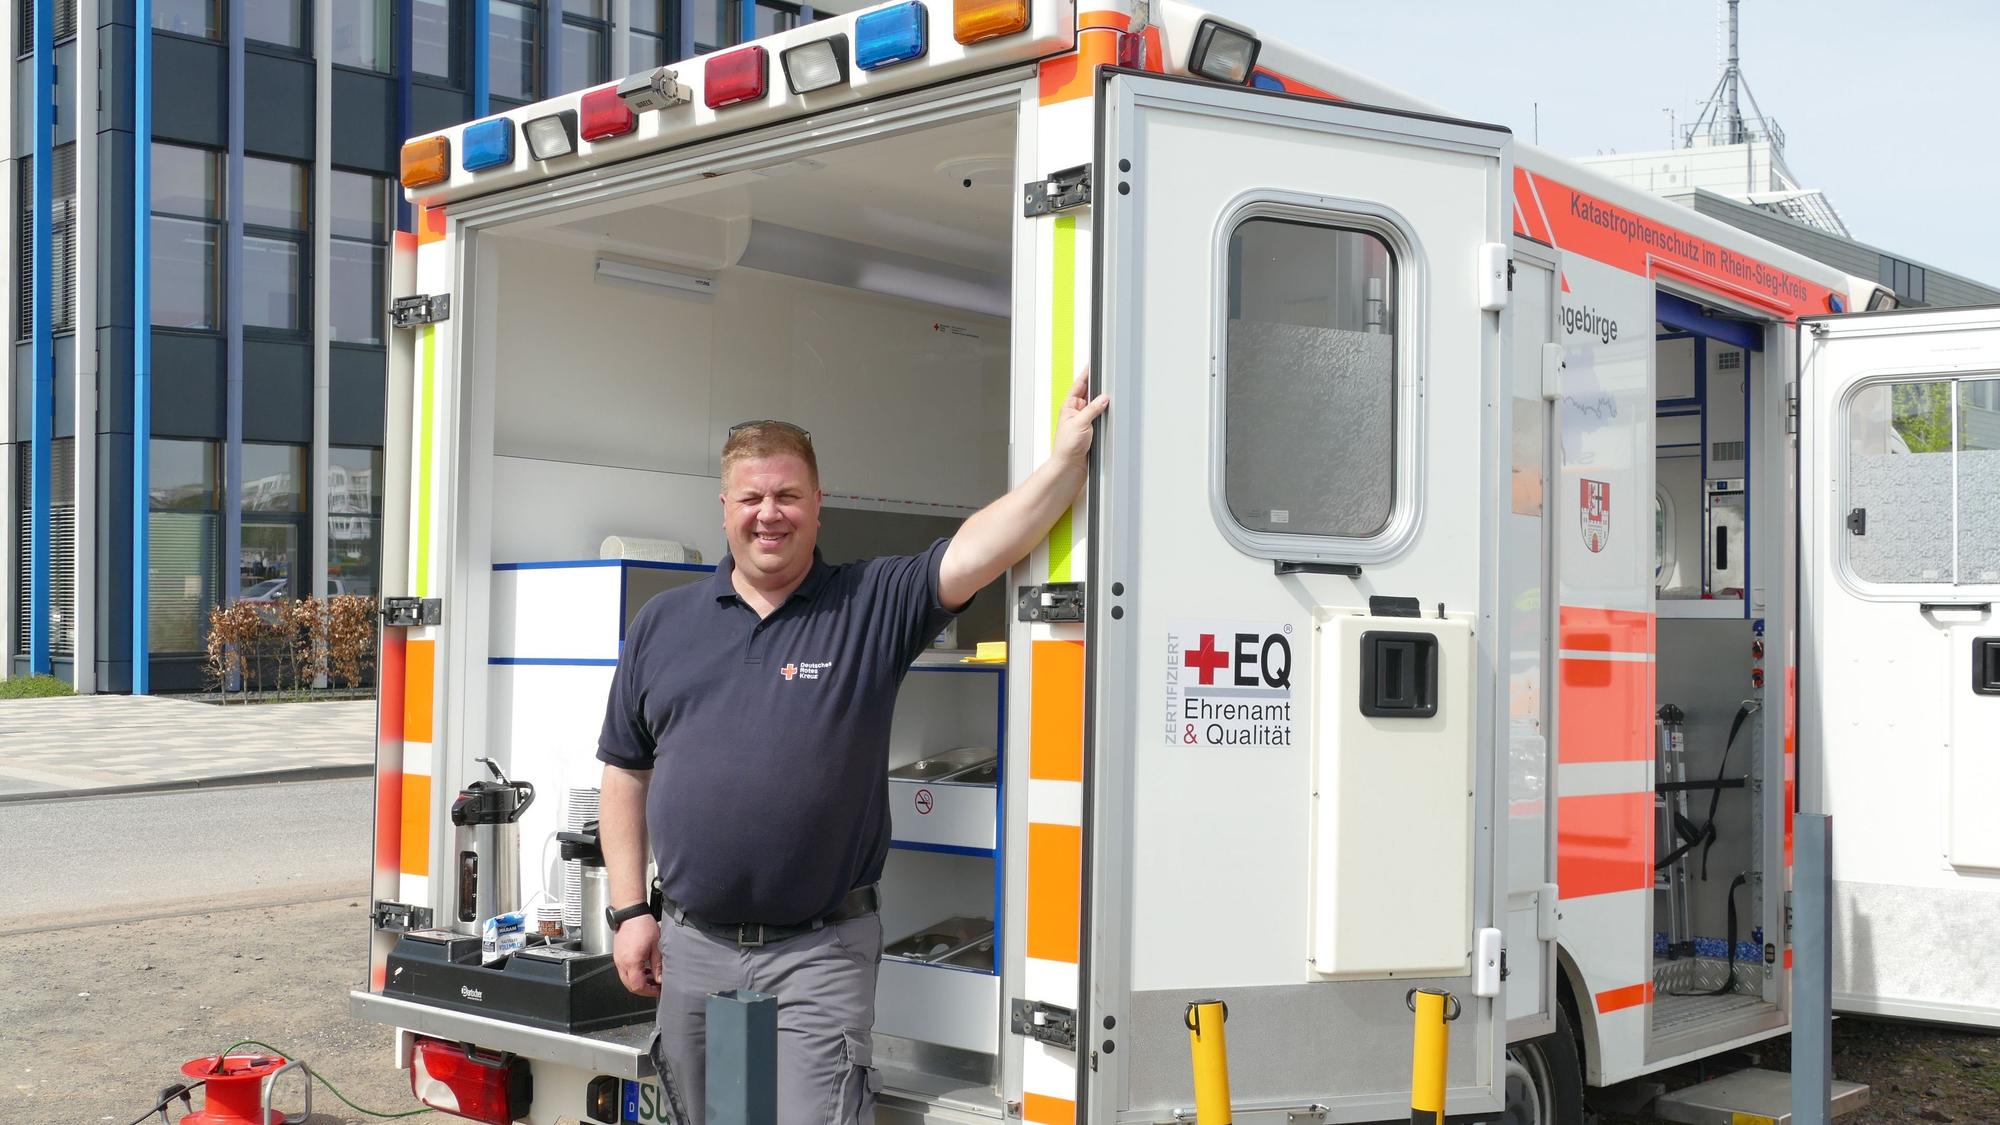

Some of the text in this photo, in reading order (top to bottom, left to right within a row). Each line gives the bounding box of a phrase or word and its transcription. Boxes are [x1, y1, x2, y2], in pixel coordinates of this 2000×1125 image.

[1570, 191, 1808, 302] Katastrophenschutz im Rhein-Sieg-Kreis
[800, 661, 832, 669] Deutsches
[1234, 632, 1292, 690] EQ
[1165, 632, 1179, 745] ZERTIFIZIERT
[1184, 698, 1291, 721] Ehrenamt
[1183, 723, 1292, 746] & Qualität
[629, 1101, 635, 1113] D
